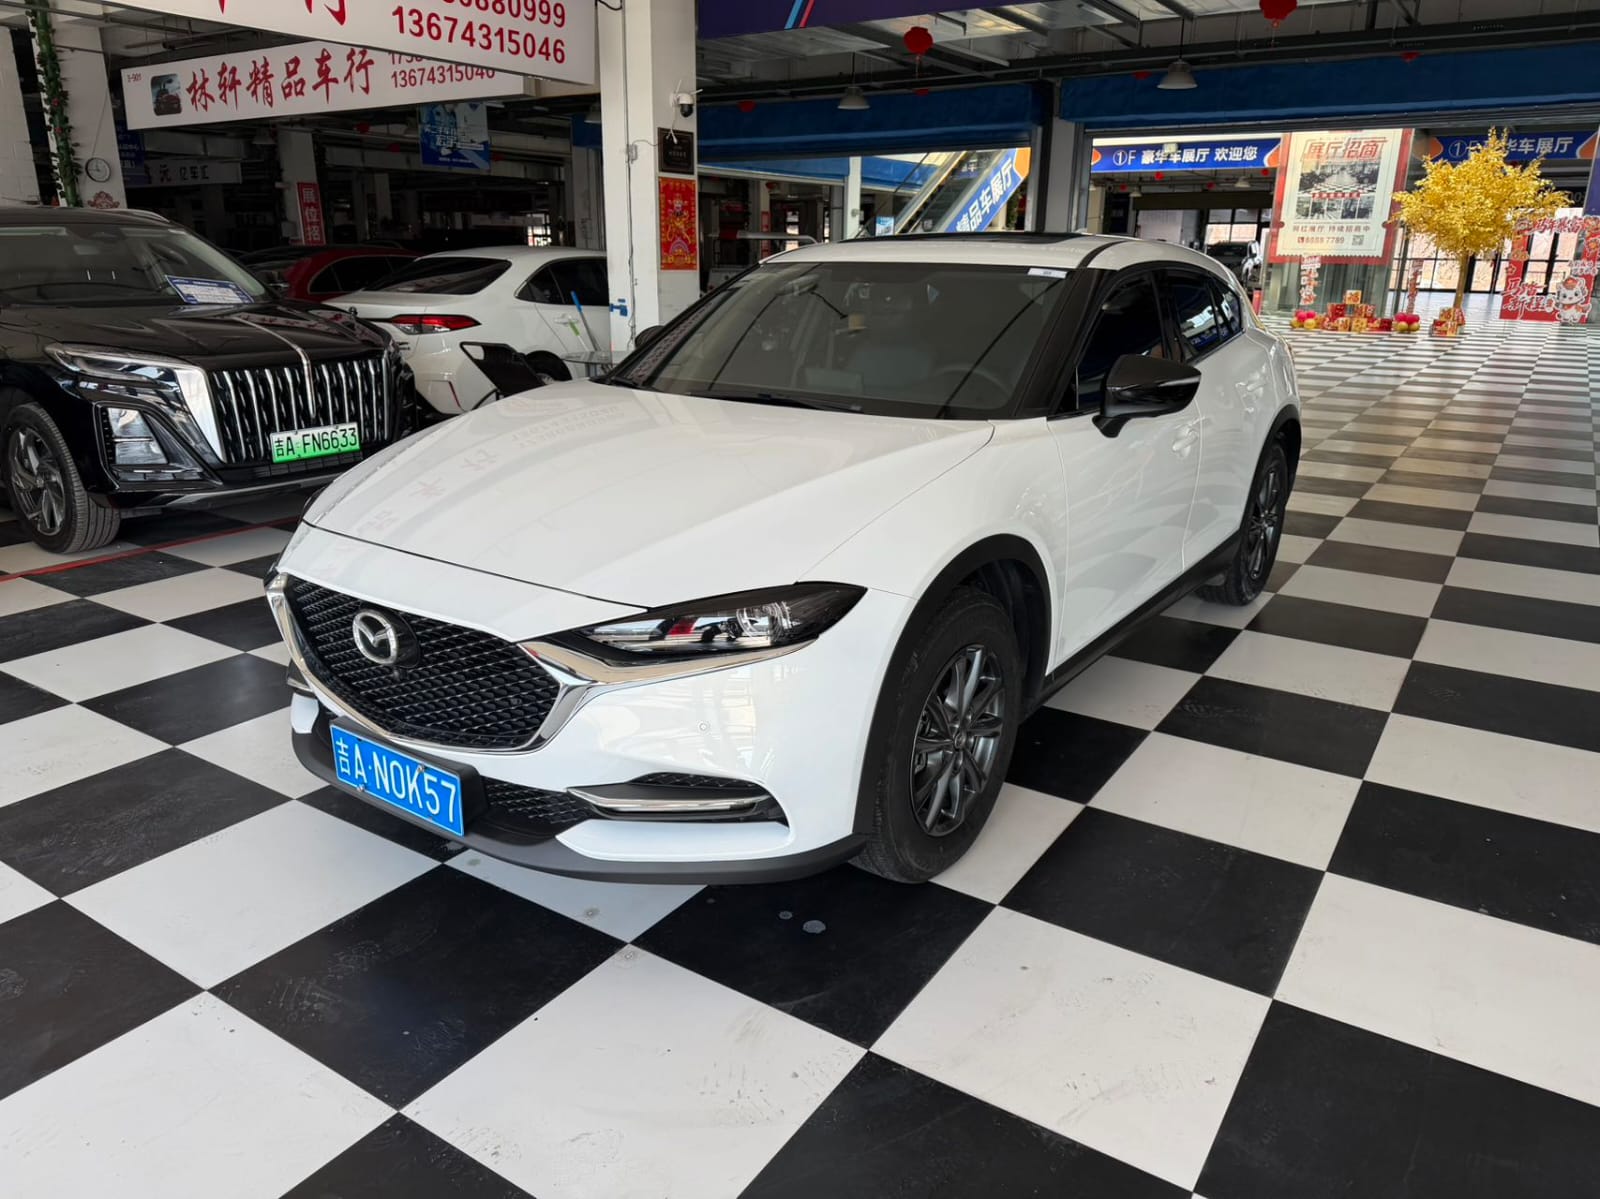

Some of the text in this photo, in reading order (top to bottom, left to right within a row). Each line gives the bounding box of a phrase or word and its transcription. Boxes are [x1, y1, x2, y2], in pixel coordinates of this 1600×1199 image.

[392, 6, 566, 64] 13674315046
[185, 48, 375, 112] 林轩精品车行
[1141, 147, 1210, 165] 豪华车展厅
[1214, 146, 1258, 162] 欢迎您
[1304, 138, 1387, 160] 展厅招商
[1485, 137, 1574, 155] 华车展厅
[302, 427, 358, 454] FN6633
